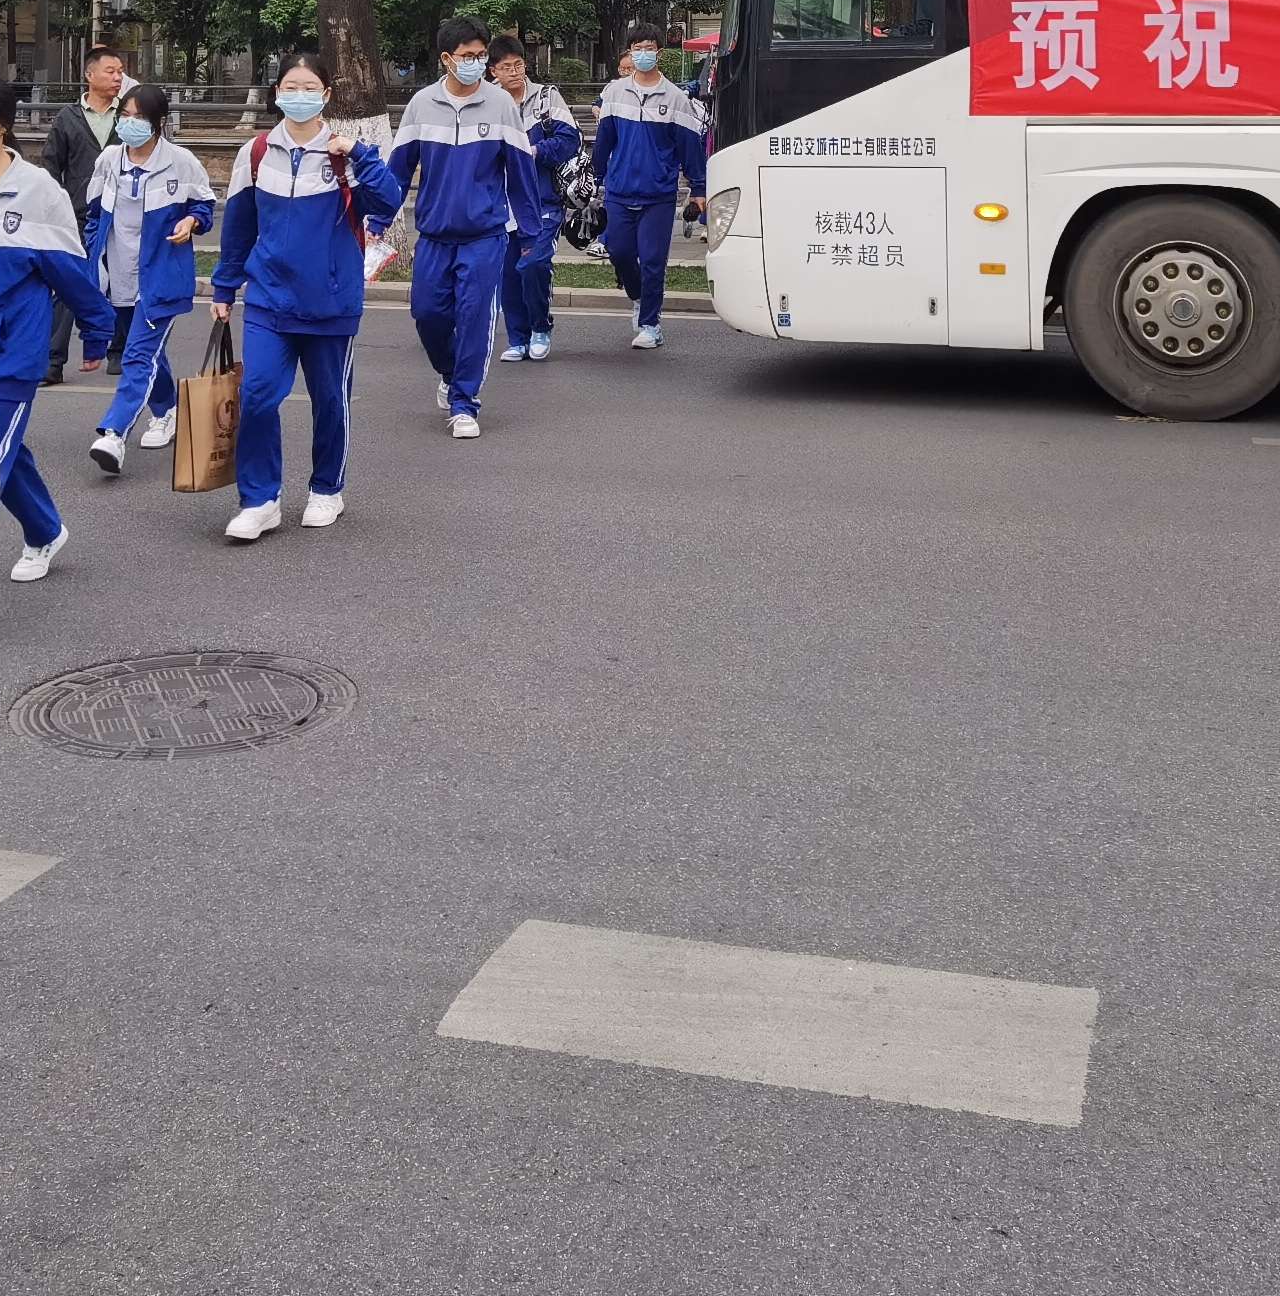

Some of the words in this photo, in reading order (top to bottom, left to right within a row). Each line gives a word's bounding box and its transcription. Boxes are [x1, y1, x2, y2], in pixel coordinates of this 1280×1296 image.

[769, 137, 936, 156] 昆明公交城市巴士有限责任公司
[815, 211, 894, 235] 核载43人
[806, 243, 905, 267] 严禁超员
